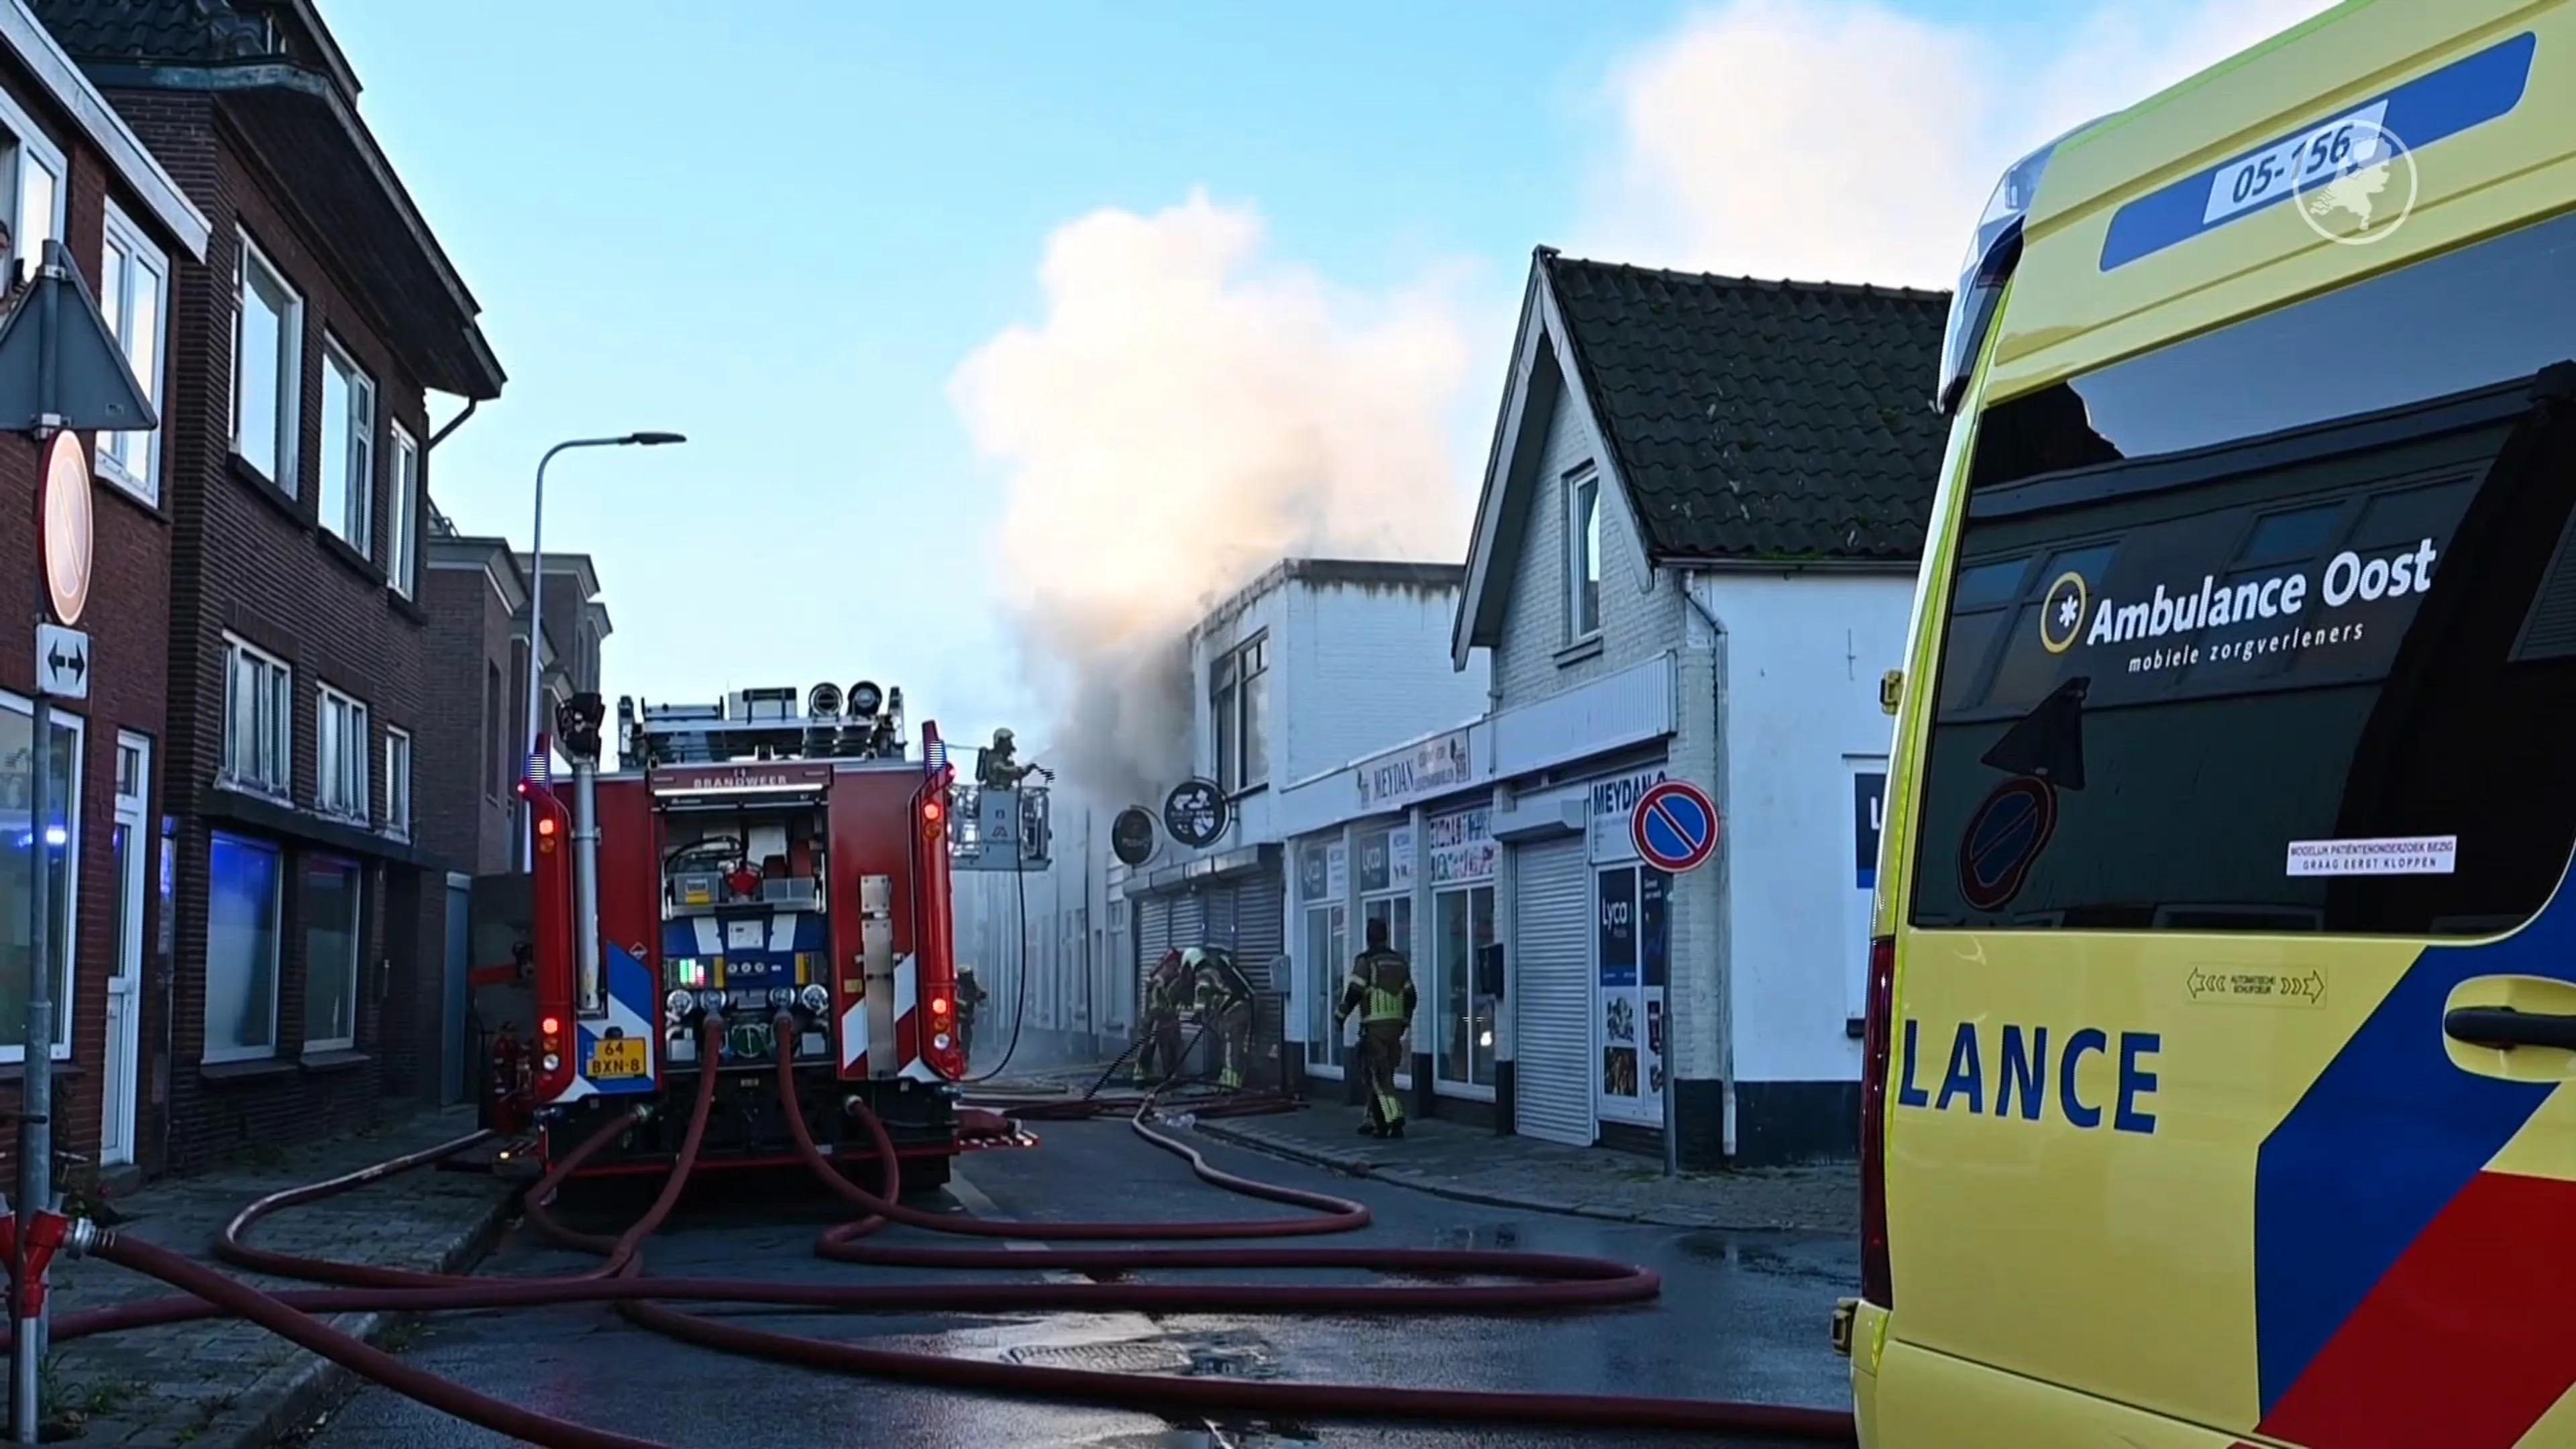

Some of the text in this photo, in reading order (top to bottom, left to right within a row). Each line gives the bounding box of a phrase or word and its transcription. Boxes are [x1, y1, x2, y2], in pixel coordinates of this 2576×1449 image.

[2232, 122, 2354, 204] 05-156
[2086, 537, 2436, 646] Ambulance Oost
[2128, 621, 2364, 672] mobiele zorgverleners
[693, 775, 787, 789] BRANDWEER
[1374, 758, 1414, 801] MEYDAN
[2302, 857, 2436, 871] GRAAG EERST KLOPPEN
[604, 1041, 624, 1057] 64
[1898, 1019, 2161, 1134] LANCE
